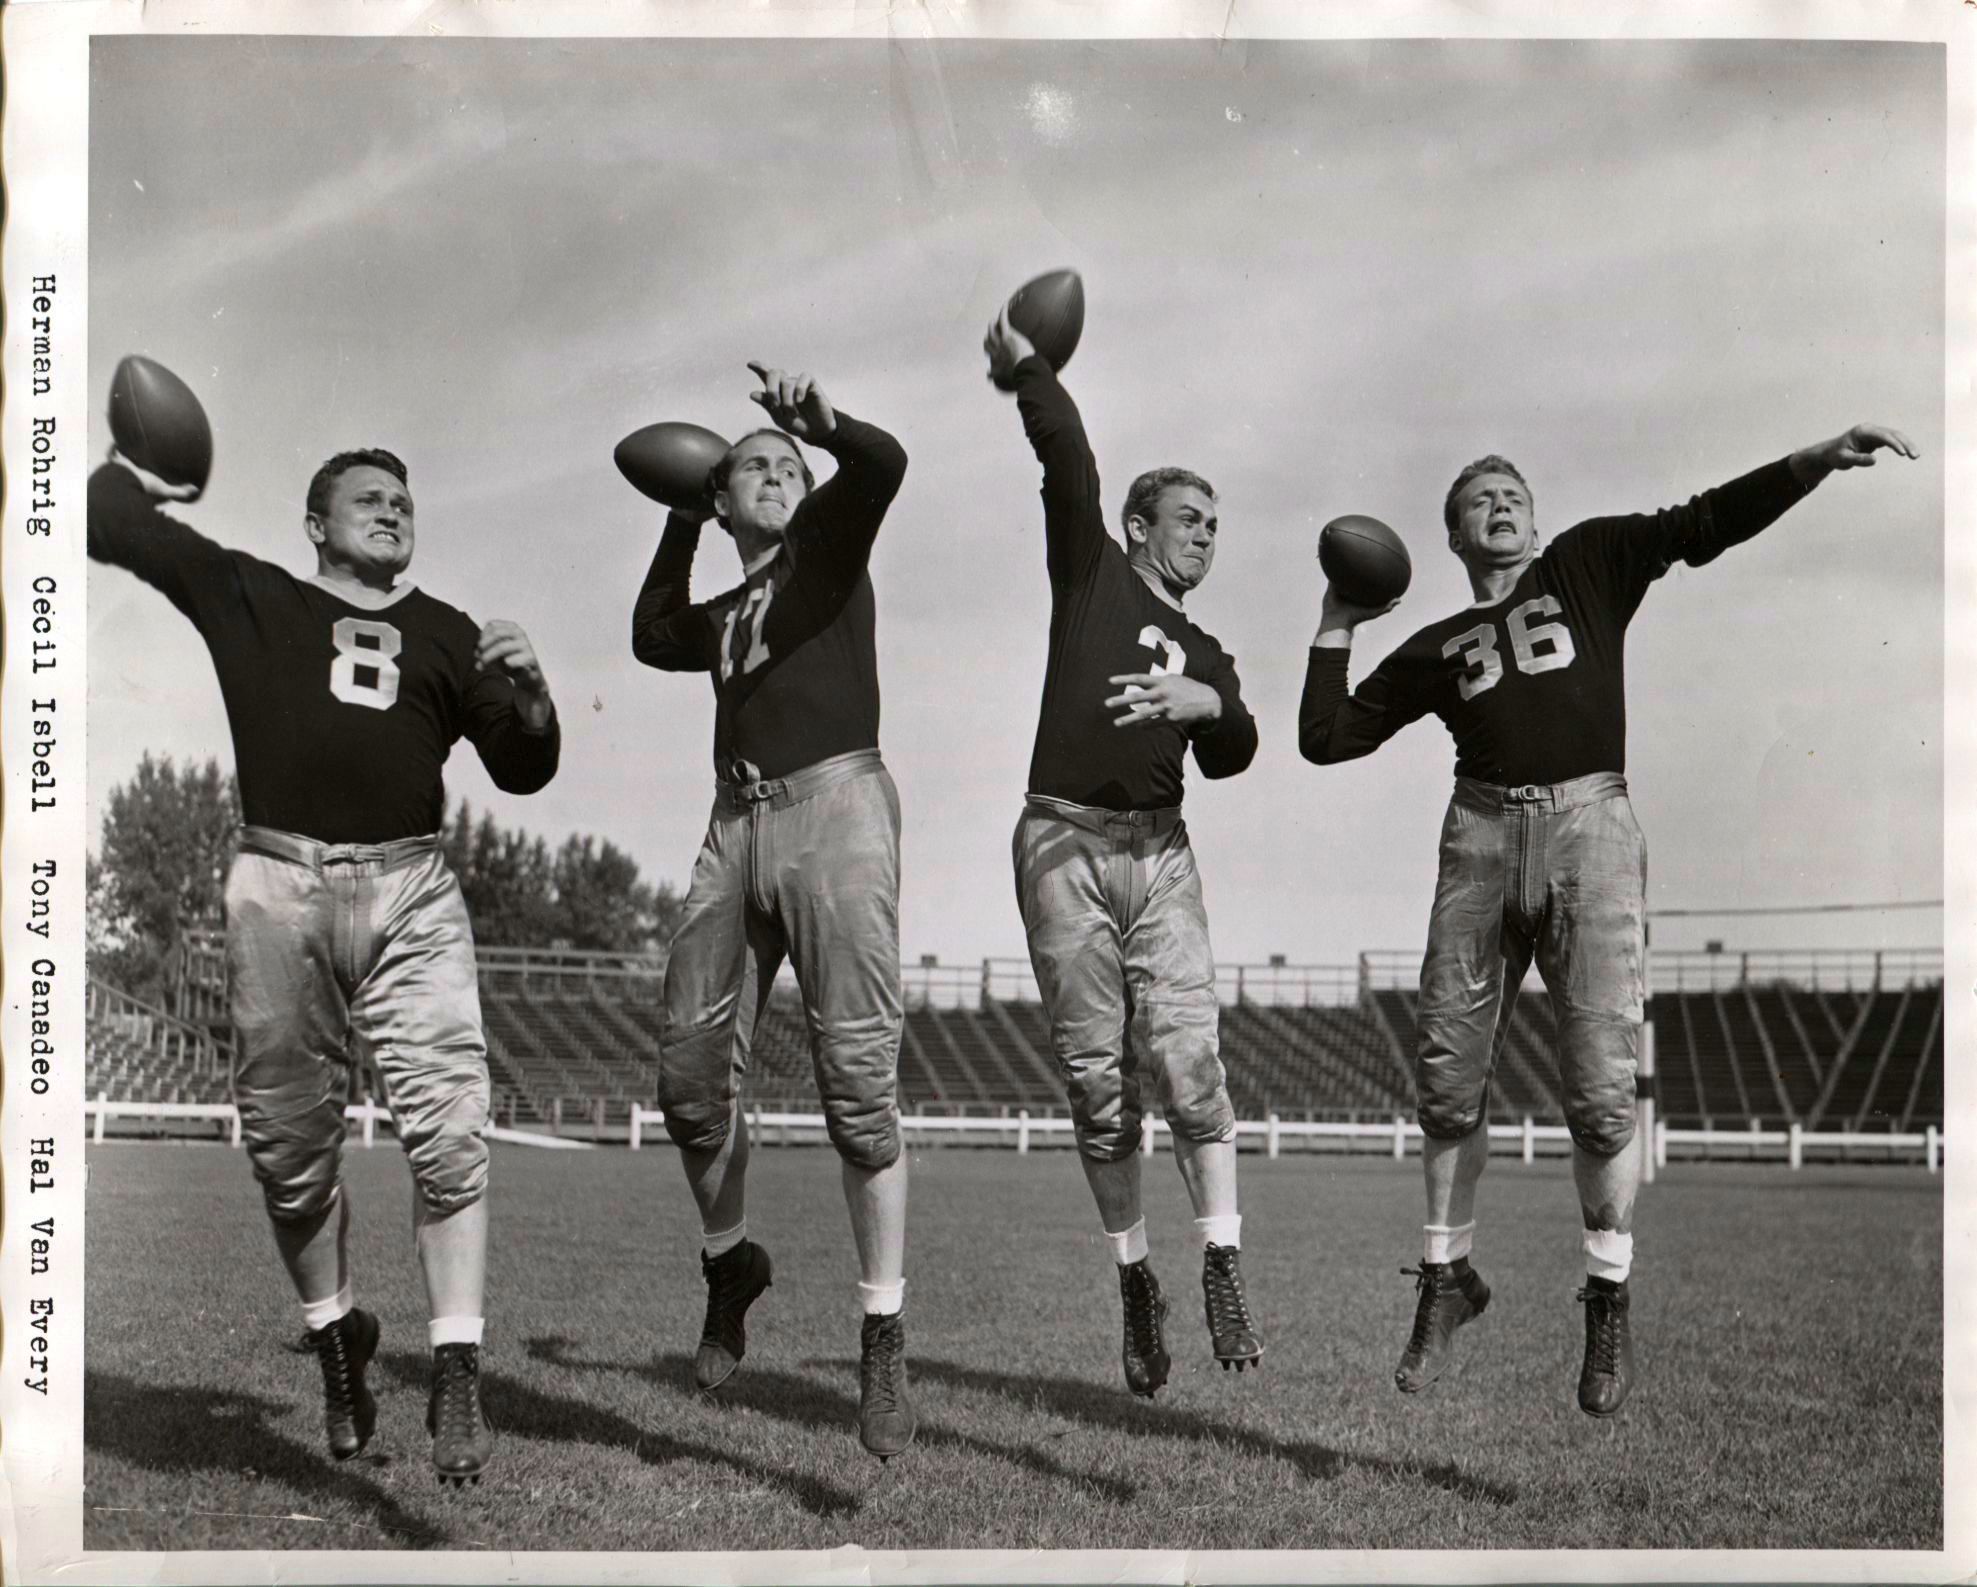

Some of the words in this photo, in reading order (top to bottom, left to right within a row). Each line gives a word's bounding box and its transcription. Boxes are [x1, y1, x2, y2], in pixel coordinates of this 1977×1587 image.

[32, 274, 56, 396] Herman
[26, 417, 56, 537] Rohrig
[32, 576, 57, 674] Cecil
[330, 617, 402, 711] 8
[1441, 594, 1576, 701] 36
[31, 698, 57, 813] Isbell
[25, 859, 57, 939] Tony
[30, 958, 56, 1095] Canadeo
[30, 1137, 55, 1194] Hal
[30, 1217, 55, 1275] Van
[24, 1297, 54, 1396] Every
